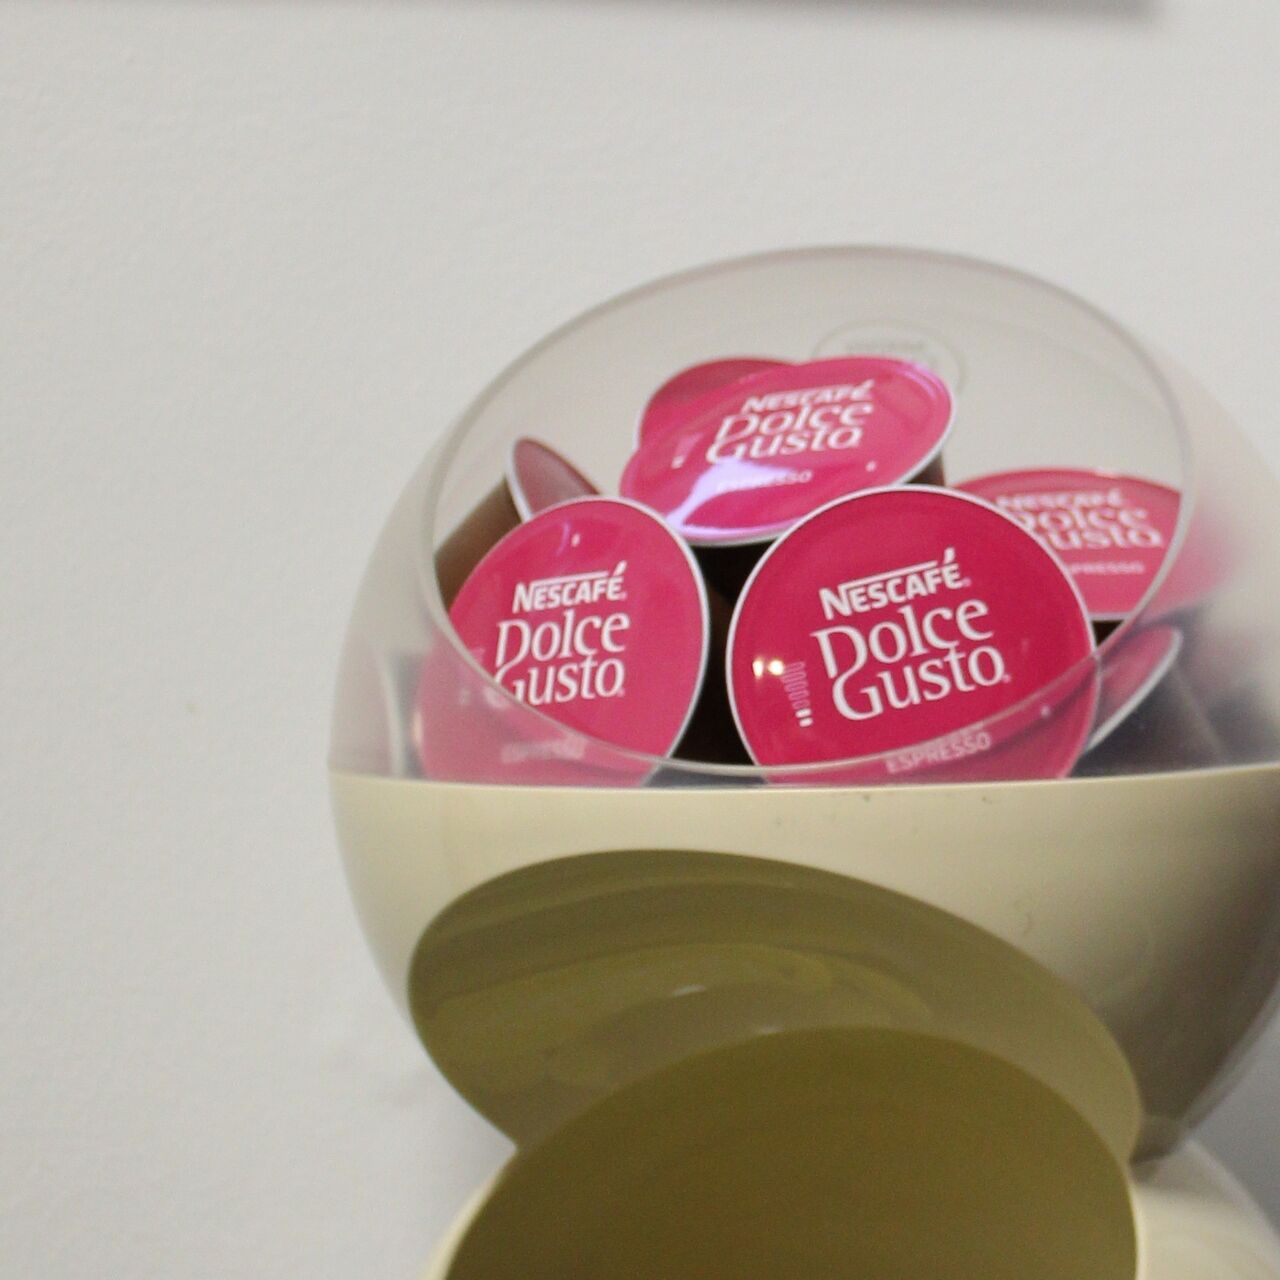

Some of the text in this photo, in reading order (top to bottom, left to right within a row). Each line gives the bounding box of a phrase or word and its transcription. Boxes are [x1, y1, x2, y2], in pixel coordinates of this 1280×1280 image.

[714, 398, 874, 453] Dolce
[1044, 523, 1163, 550] usto
[512, 560, 627, 614] NESCAFÉ
[818, 547, 964, 621] NESCAFÉ
[496, 609, 629, 668] Dolce
[810, 598, 994, 680] Dolce
[831, 644, 1005, 721] Gusto
[885, 732, 992, 773] ESPRESSO
